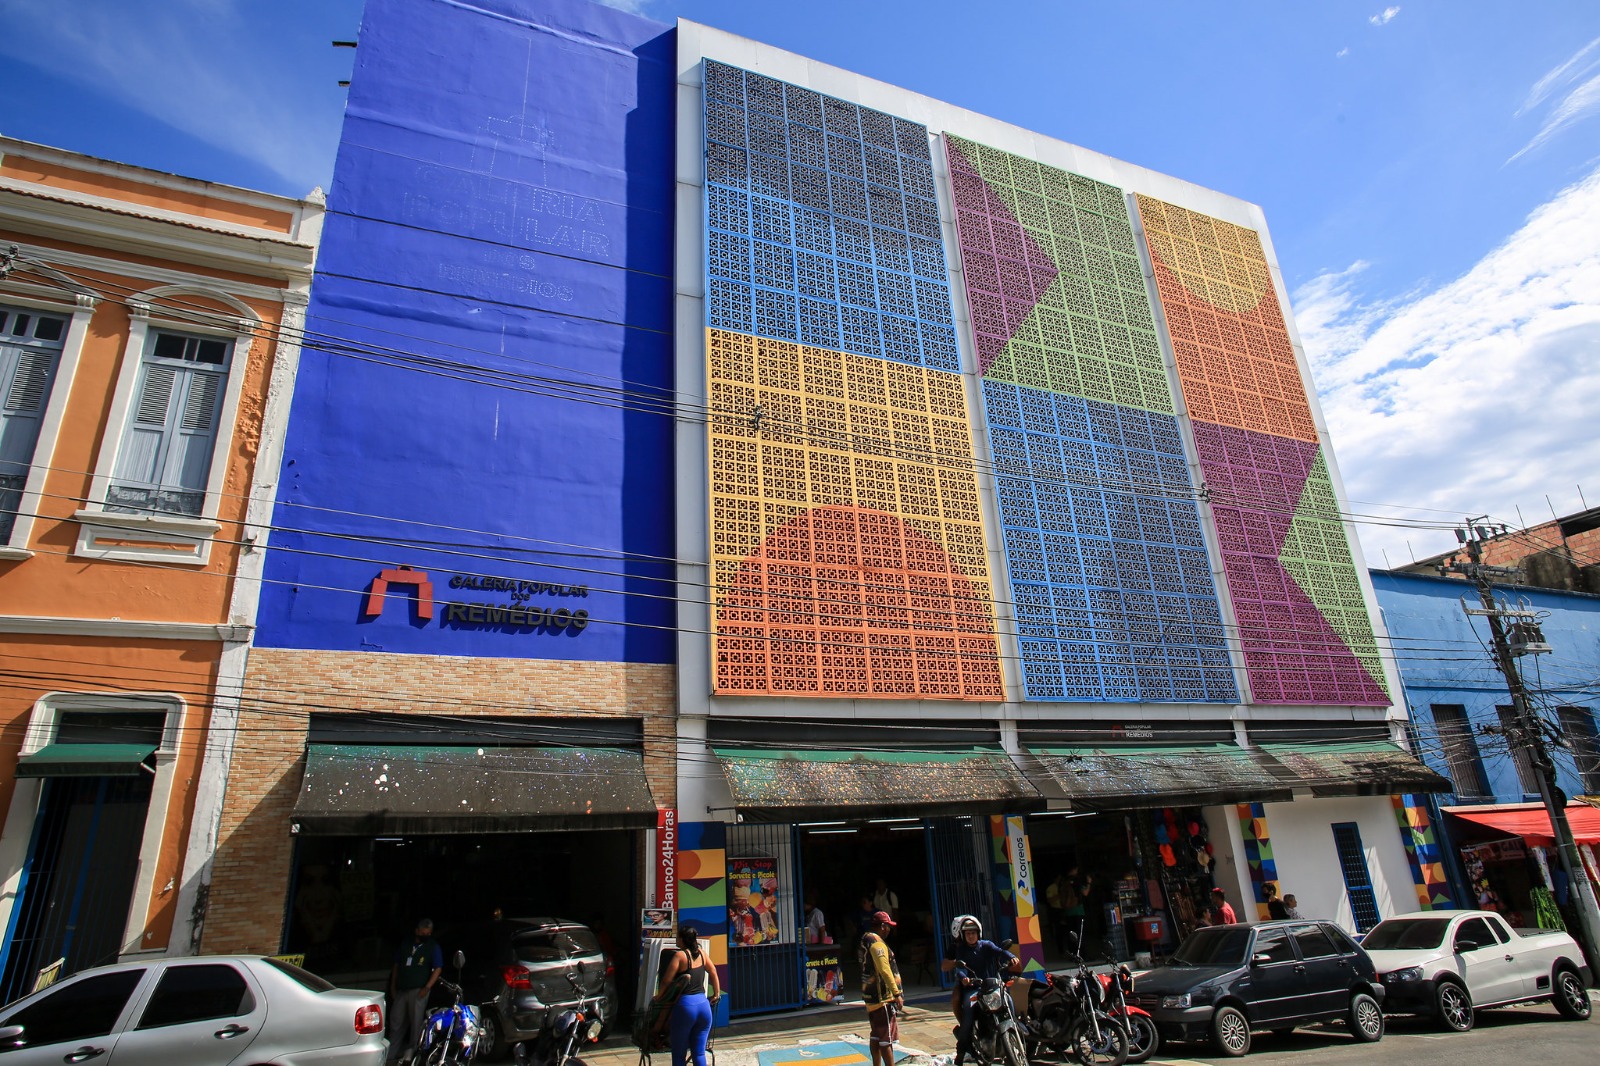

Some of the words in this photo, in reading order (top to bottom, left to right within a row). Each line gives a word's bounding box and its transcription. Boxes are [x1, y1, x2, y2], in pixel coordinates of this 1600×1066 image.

[452, 575, 517, 591] GALERIA
[521, 580, 589, 597] POPULAR
[510, 591, 530, 601] DOS
[447, 600, 590, 630] REMÉDIOS
[661, 810, 675, 910] Banco24Horas
[1016, 837, 1027, 878] Correios
[729, 872, 751, 880] Sorvete
[757, 871, 775, 879] Picolé
